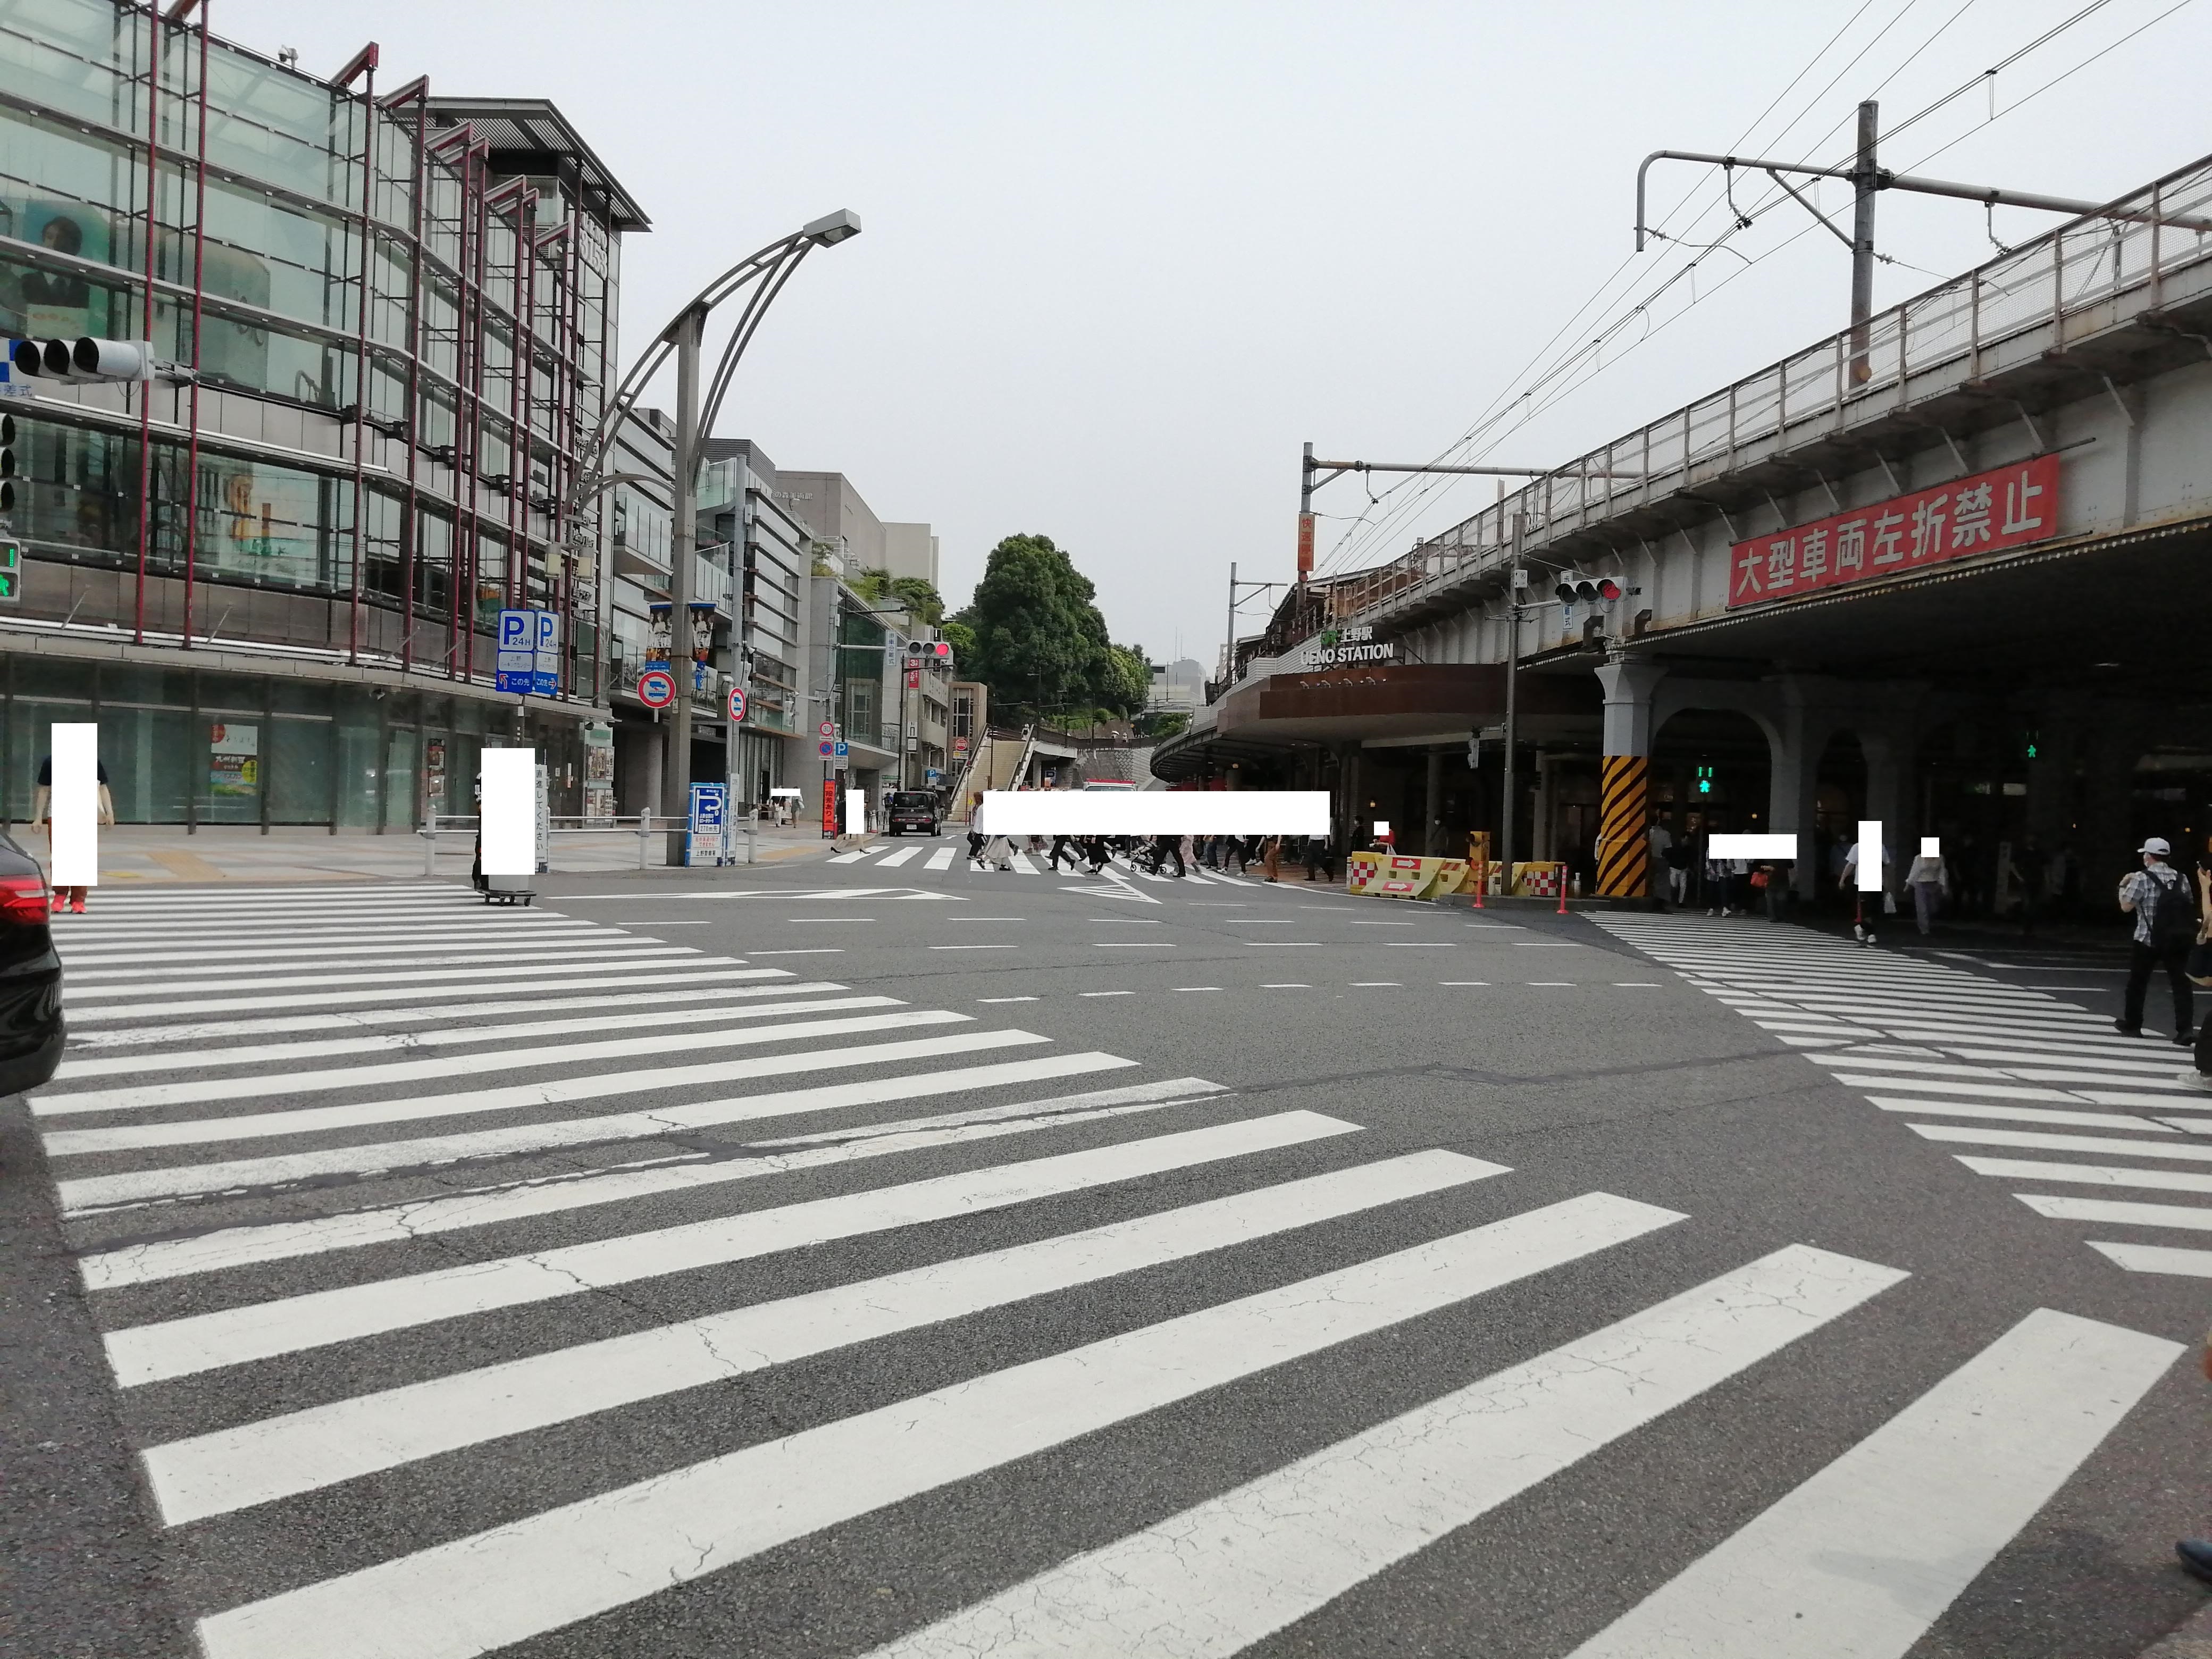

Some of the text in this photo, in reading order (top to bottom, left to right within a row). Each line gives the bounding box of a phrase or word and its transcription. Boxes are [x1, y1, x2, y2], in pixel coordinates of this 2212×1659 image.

[1736, 470, 2043, 598] 大型車両左折禁止
[504, 616, 524, 645] P
[540, 616, 553, 647] P
[1340, 626, 1373, 643] 上野駅
[513, 637, 531, 646] 24H
[546, 638, 557, 648] 24H
[1300, 643, 1394, 665] UENO STATION
[511, 678, 530, 686] この先
[537, 678, 548, 686] この先
[838, 744, 846, 755] P
